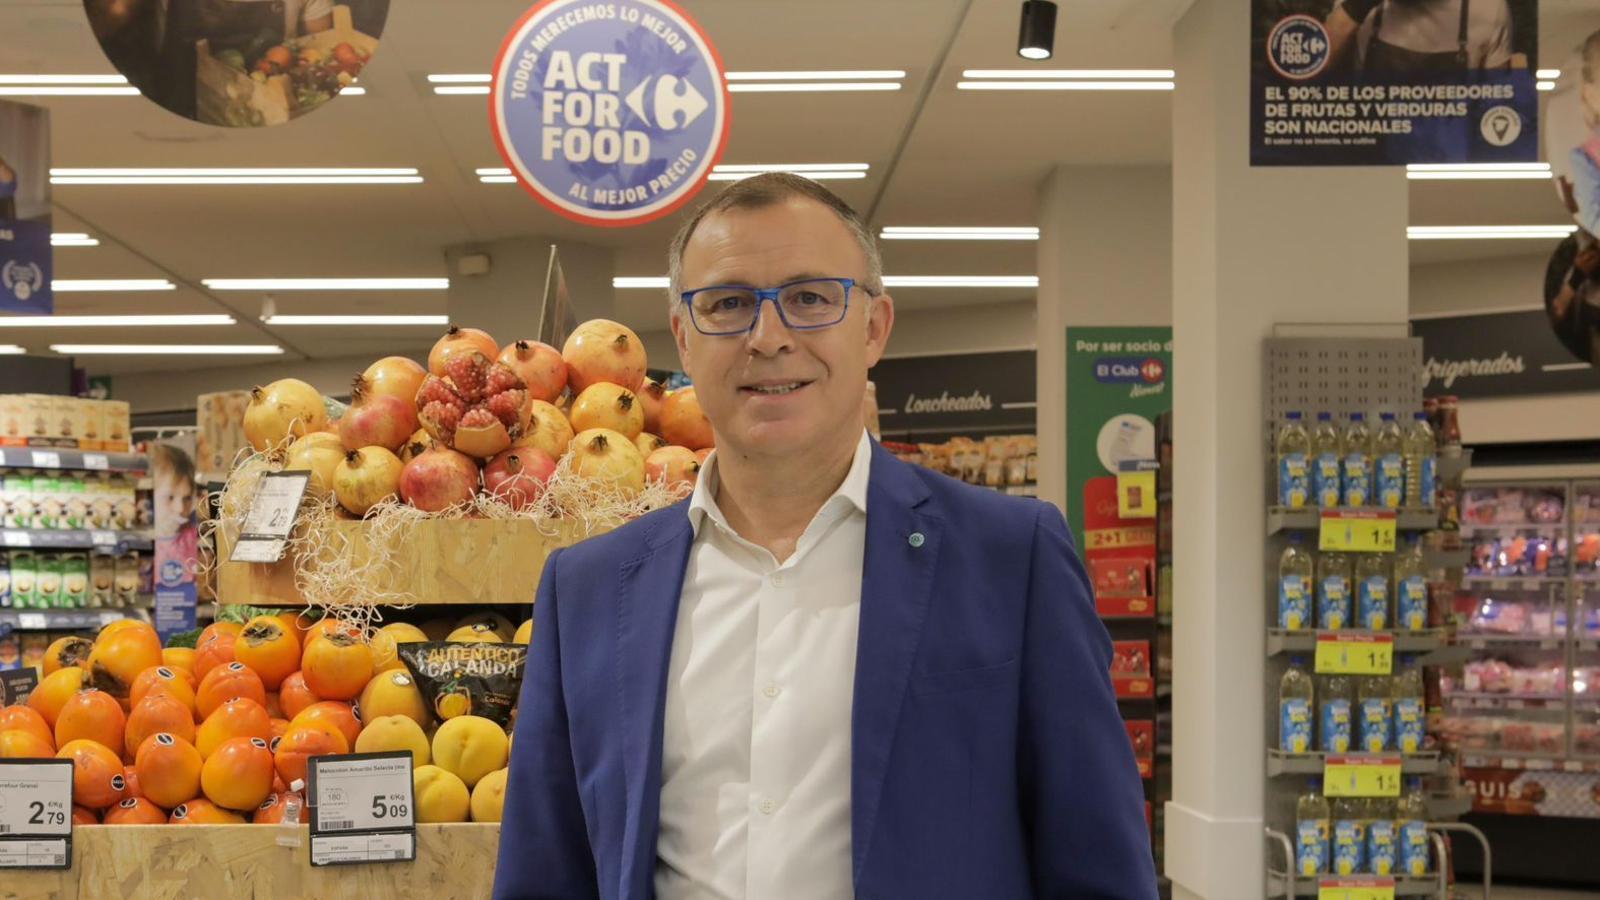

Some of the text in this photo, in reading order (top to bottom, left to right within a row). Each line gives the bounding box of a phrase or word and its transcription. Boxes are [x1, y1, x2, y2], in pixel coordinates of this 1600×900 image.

[1281, 32, 1303, 43] ACT
[1281, 43, 1302, 53] FOR
[511, 4, 687, 100] TODOS MERECEMOS LO MEJOR
[1281, 53, 1310, 64] FOOD
[543, 51, 627, 92] ACT
[1265, 84, 1514, 100] EL 90% DE LOS PROVEEDORES
[542, 92, 621, 128] FOR
[1265, 103, 1288, 117] DE
[1291, 103, 1356, 117] FRUTAS
[1360, 103, 1371, 117] Y
[1375, 102, 1468, 117] VERDURAS
[1265, 120, 1412, 134] SON NACIONALES
[542, 127, 650, 164] FOOD
[568, 148, 697, 205] AL MEJOR PRECIO
[1076, 340, 1098, 352] Por
[1102, 342, 1122, 352] ser
[1126, 339, 1161, 352] socio
[1096, 364, 1139, 376] El Club
[1422, 351, 1526, 389] frigerados
[904, 390, 993, 414] Loncheados
[28, 801, 65, 826] 2 79
[372, 795, 408, 819] 5 09
